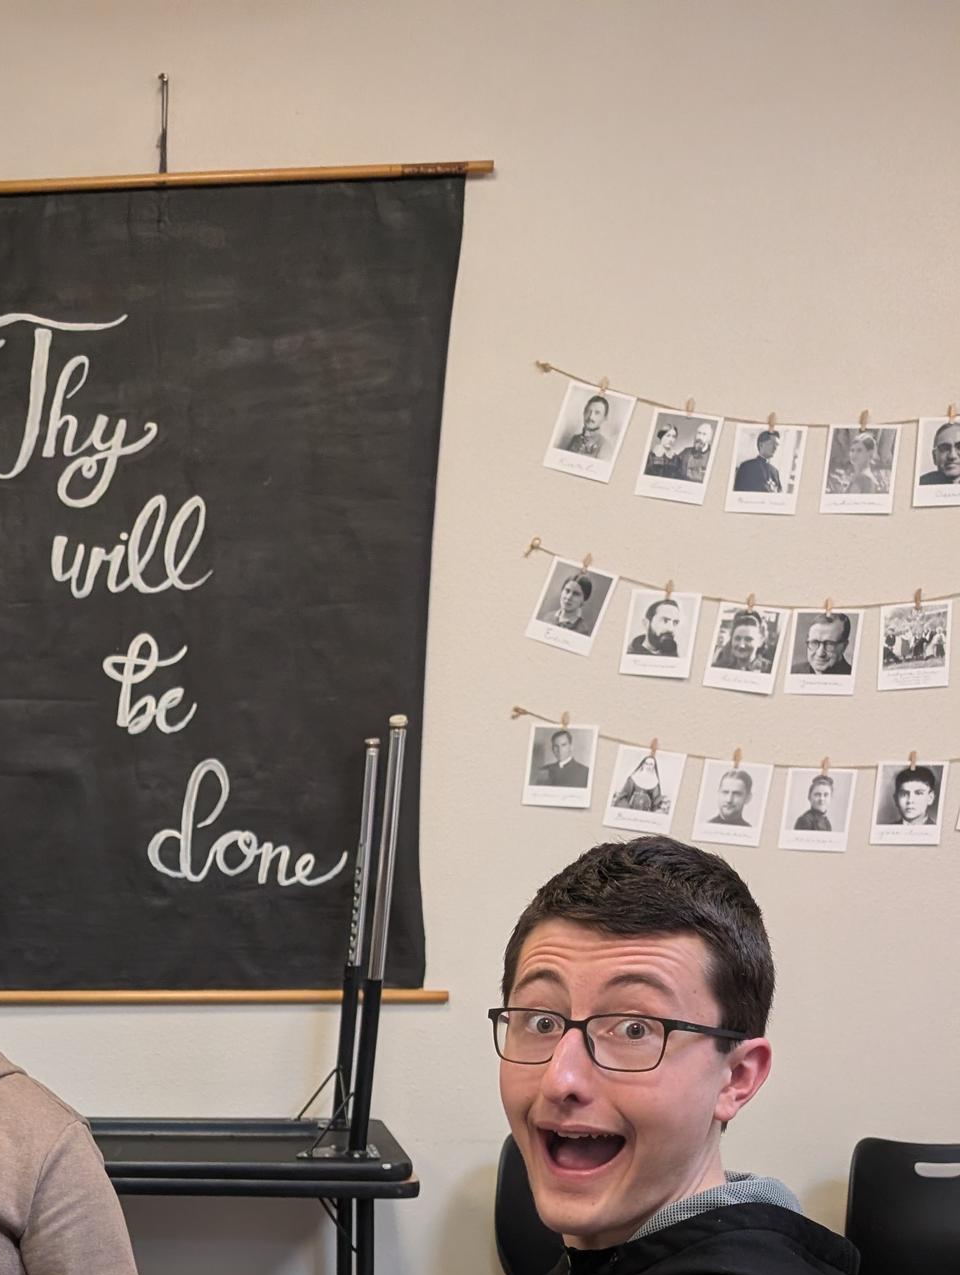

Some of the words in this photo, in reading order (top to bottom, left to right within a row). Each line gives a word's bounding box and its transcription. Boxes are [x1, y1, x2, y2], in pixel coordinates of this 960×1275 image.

[51, 495, 214, 598] will
[103, 633, 197, 734] be
[148, 758, 347, 886] done
